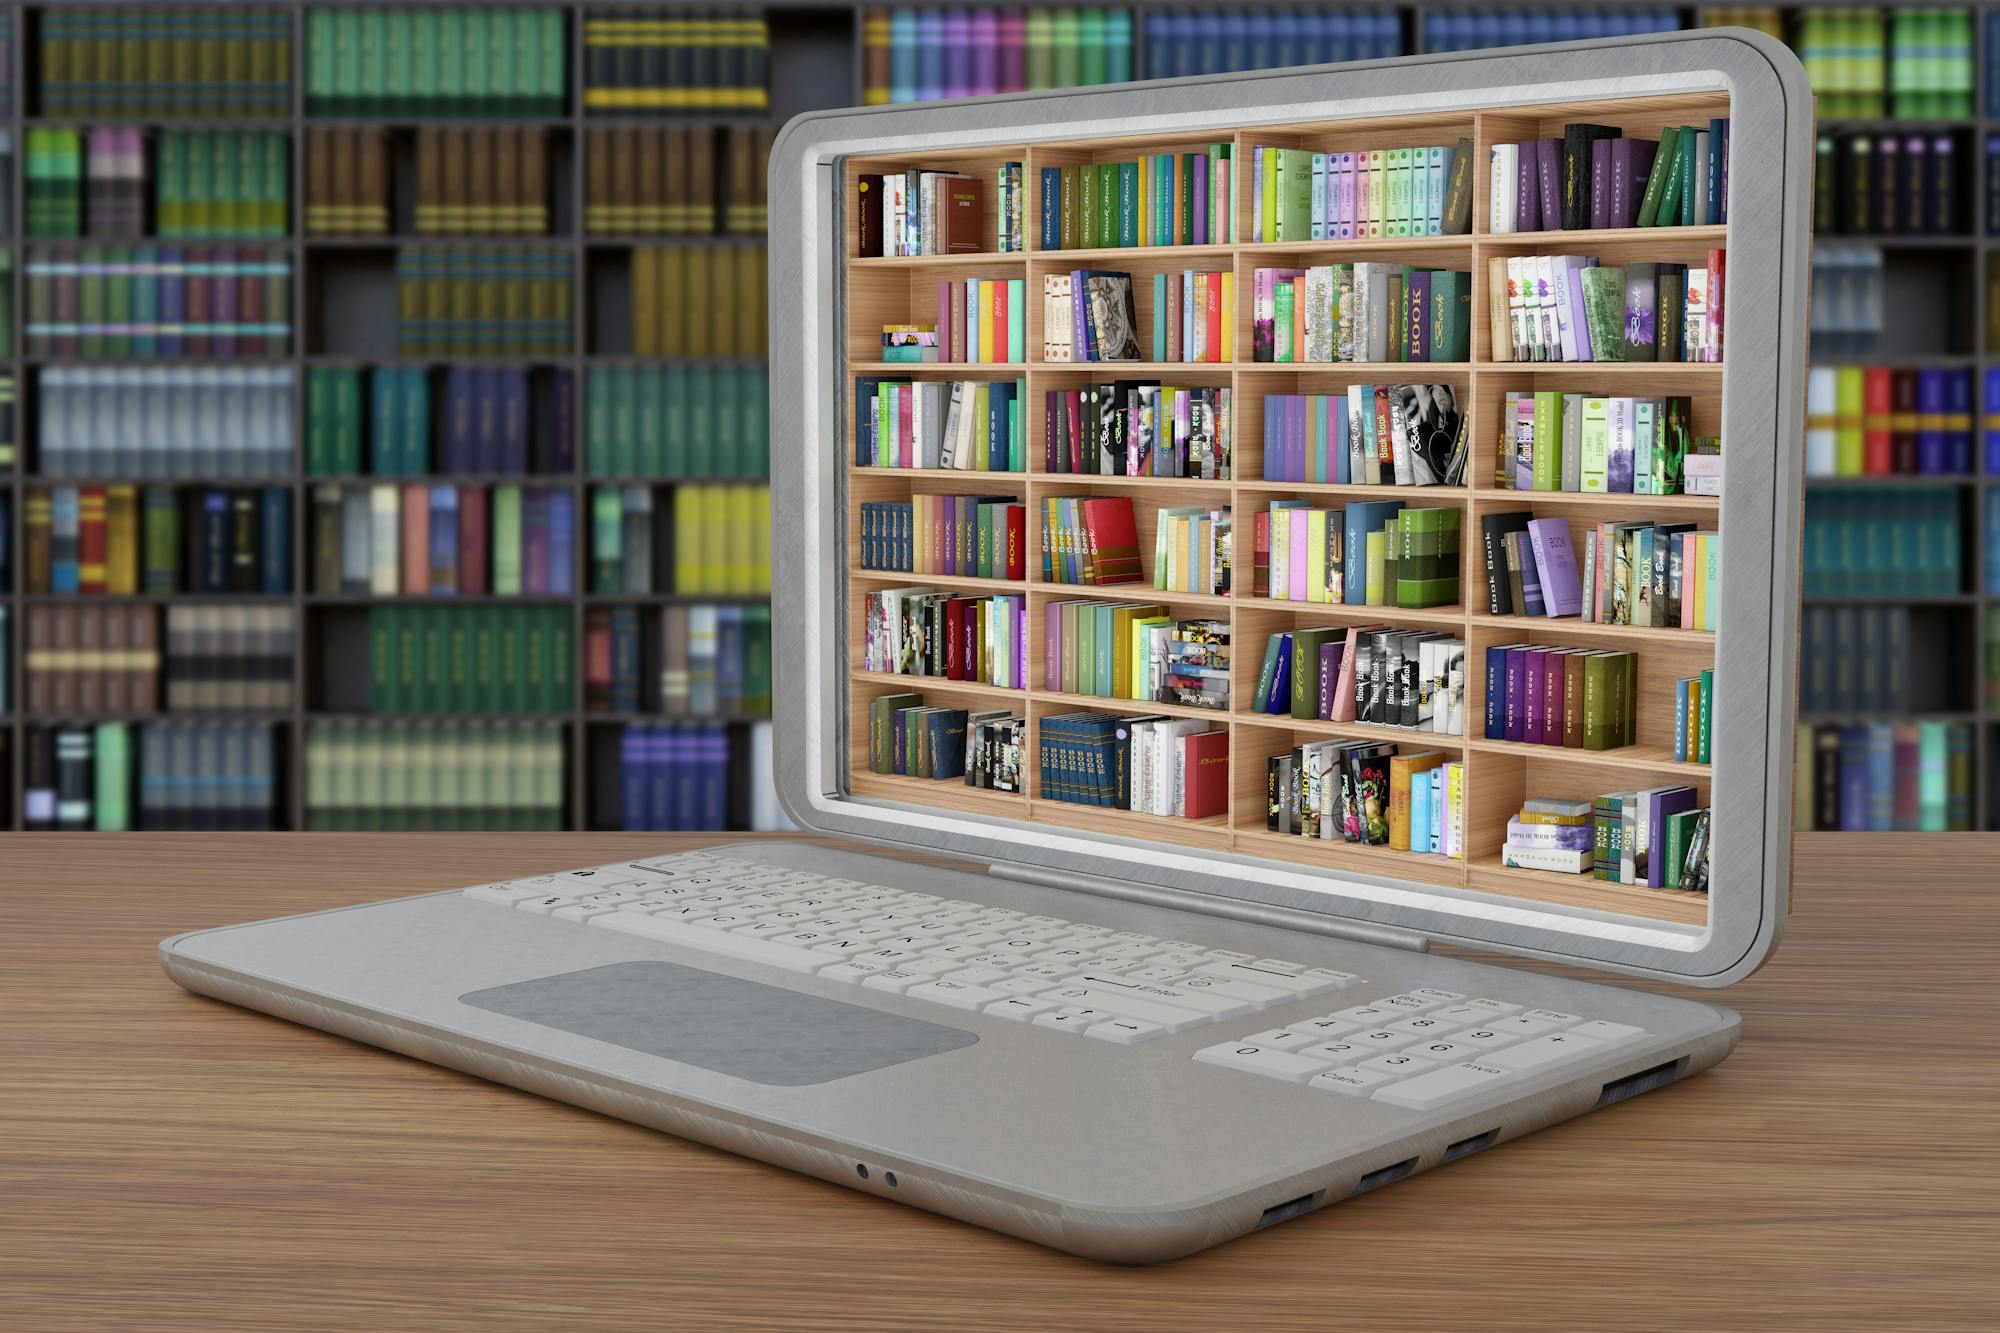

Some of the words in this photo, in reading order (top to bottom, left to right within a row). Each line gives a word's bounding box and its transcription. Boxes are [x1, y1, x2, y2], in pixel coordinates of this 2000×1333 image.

[1647, 151, 1664, 201] BOOK
[1666, 151, 1681, 201] BOOK
[1542, 162, 1551, 216] BOOK
[1556, 274, 1566, 306] BOOK
[1413, 288, 1423, 356] BOOK
[1631, 286, 1642, 347] Book
[1377, 413, 1387, 434] Book
[1379, 434, 1388, 460] Book
[1519, 441, 1532, 463] Book
[1009, 528, 1017, 567] BOOK
[1088, 527, 1097, 556] Book
[1484, 531, 1495, 571] Book
[1533, 536, 1544, 567] BOOK
[1641, 557, 1651, 589] BOOK
[1489, 575, 1500, 614] Book
[1258, 659, 1272, 699] BOOK
[1386, 685, 1395, 706] Book
[1401, 686, 1411, 708] Book
[1042, 747, 1050, 768] BOOK
[1051, 748, 1059, 769] BOOK
[1060, 749, 1068, 770] BOOK
[1068, 750, 1076, 771] BOOK
[1077, 751, 1085, 772] BOOK
[1086, 752, 1094, 773] BOOK
[1096, 753, 1104, 774] BOOK
[1596, 826, 1608, 848] BOOK
[1611, 828, 1622, 850] BOOK
[1639, 819, 1647, 854] BOOK
[831, 941, 859, 949] N
[873, 950, 904, 959] M
[1137, 984, 1185, 998] Enter
[1411, 1020, 1436, 1028] 8
[1369, 1032, 1396, 1040] 5
[1470, 1031, 1495, 1039] 9
[1325, 1044, 1352, 1053] 2
[1428, 1044, 1455, 1052] 6
[1386, 1056, 1411, 1065] 3
[1460, 1062, 1502, 1076] Invio
[1321, 1072, 1365, 1086] Canc
